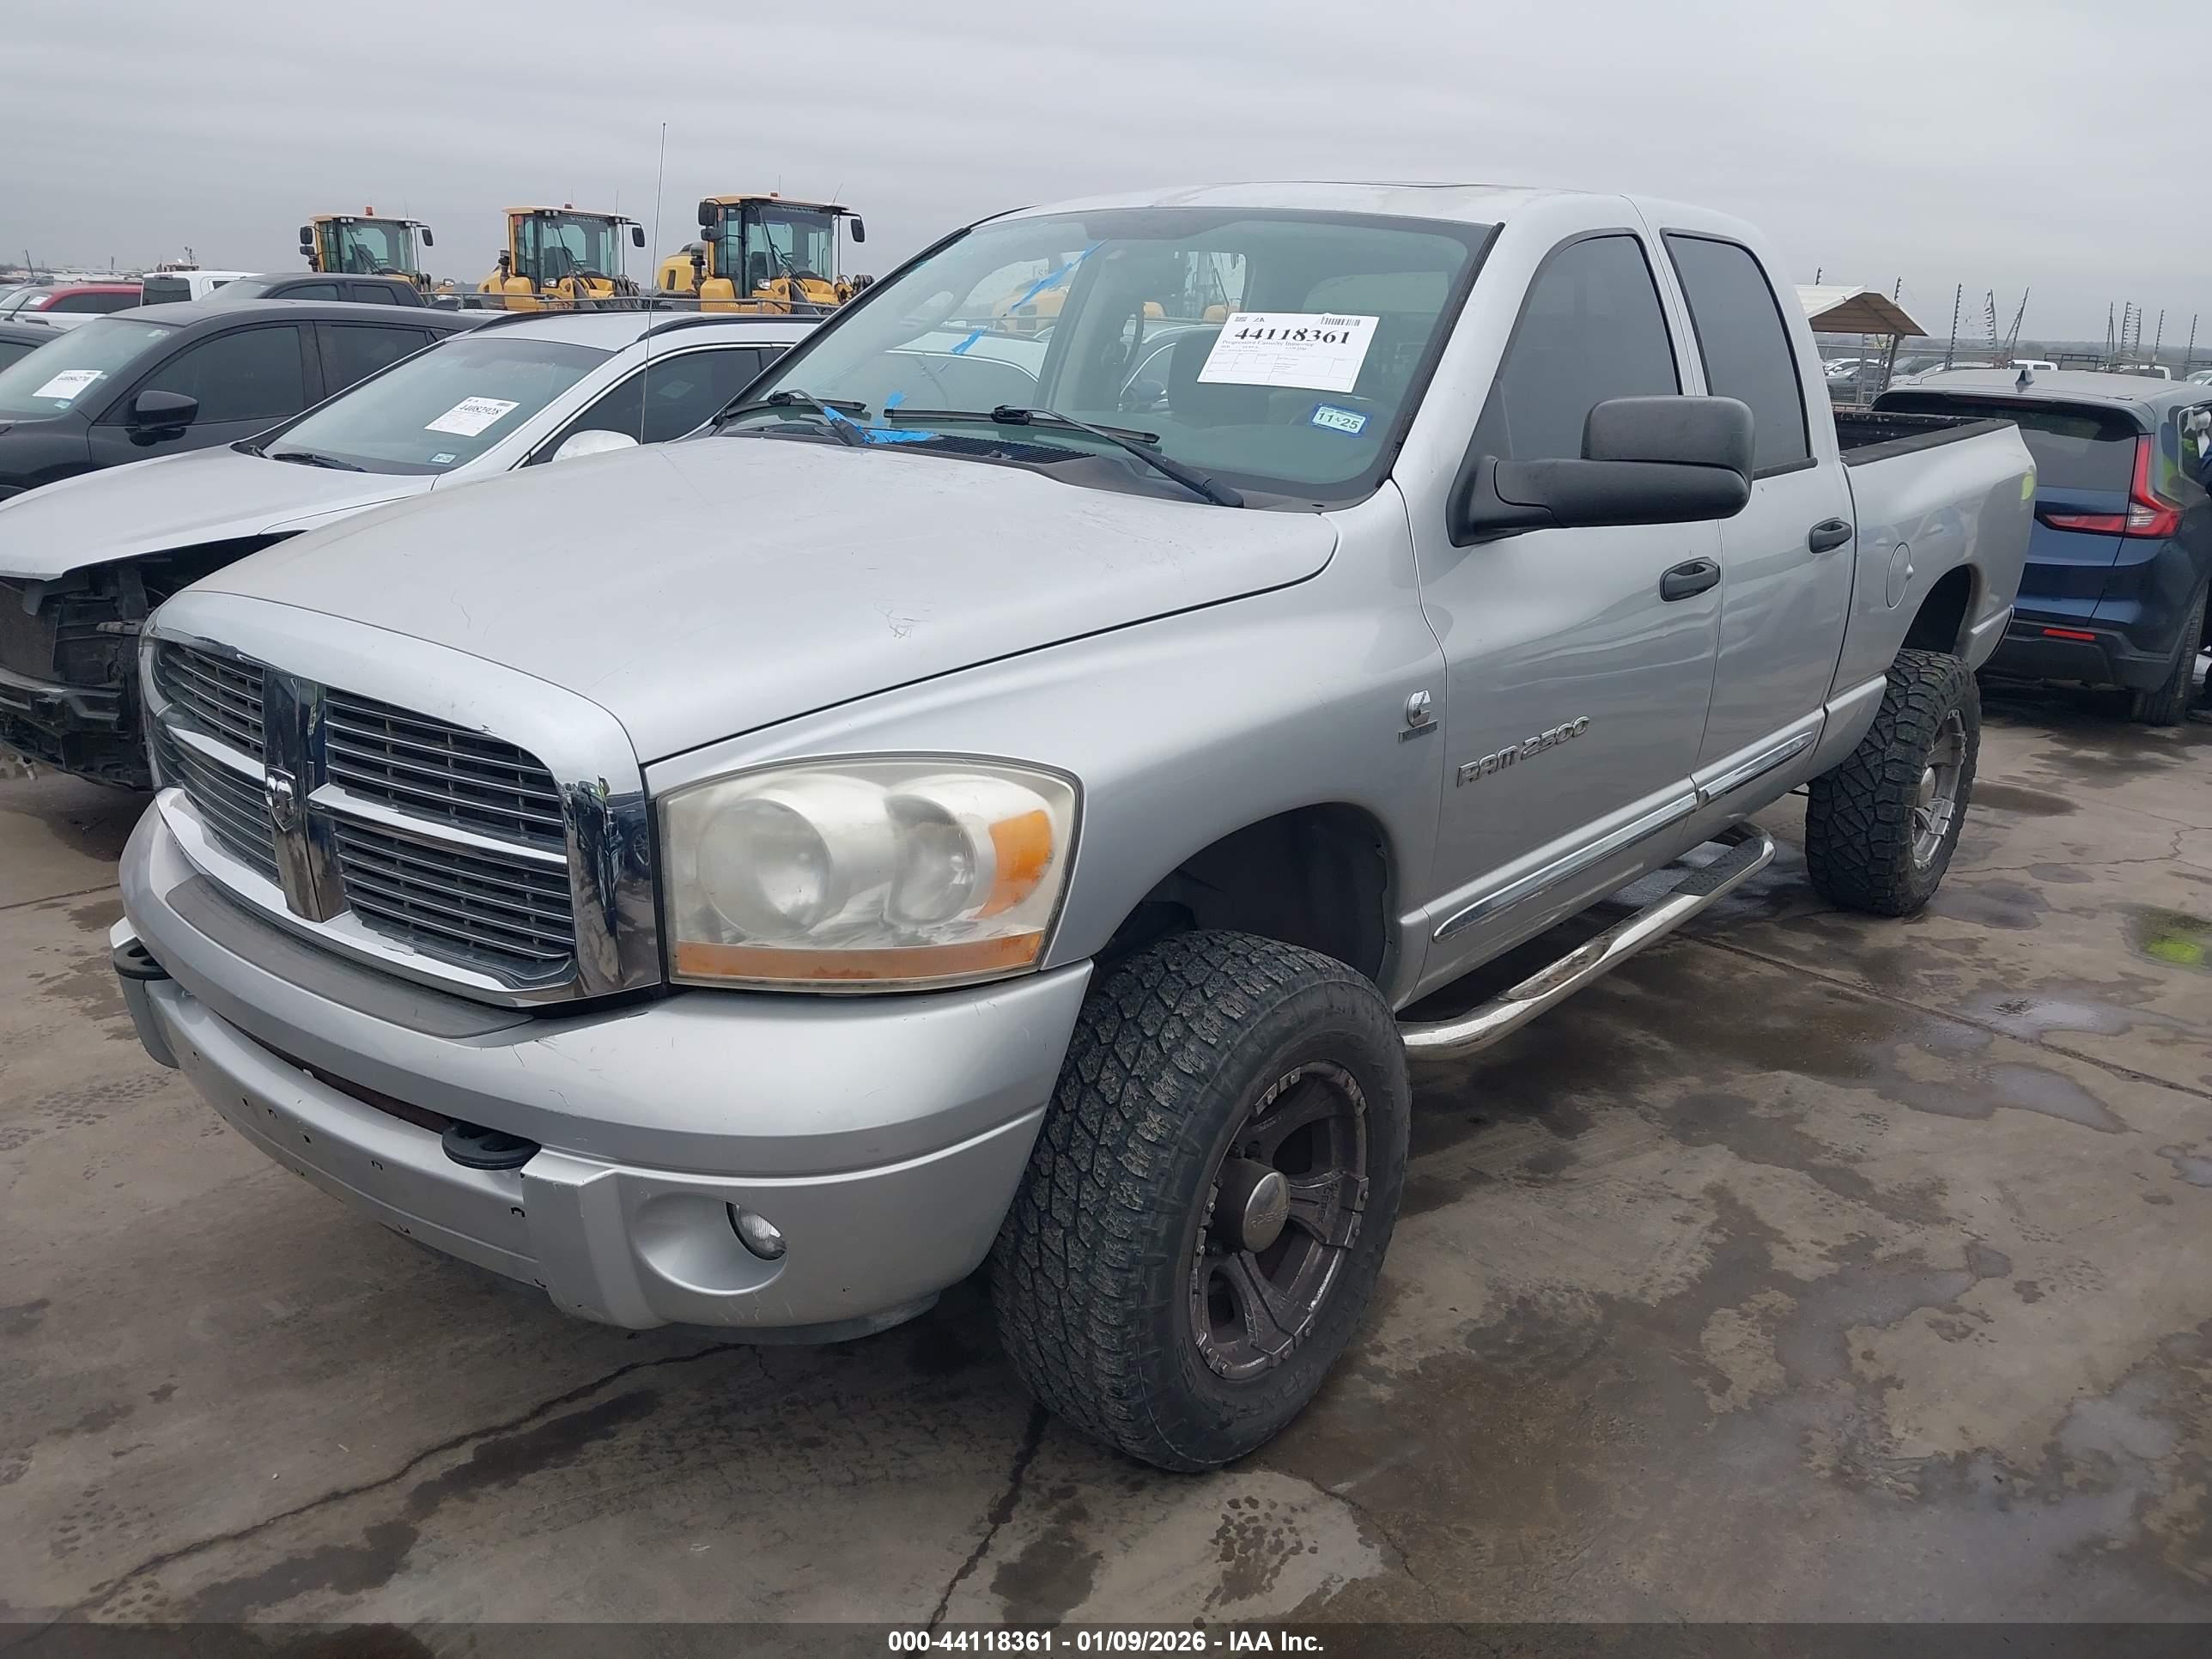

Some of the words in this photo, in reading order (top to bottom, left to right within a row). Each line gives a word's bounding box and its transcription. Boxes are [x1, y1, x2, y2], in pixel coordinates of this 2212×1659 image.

[1235, 327, 1350, 344] 44118361
[1457, 745, 1518, 787] RAM
[1521, 715, 1590, 760] 2500
